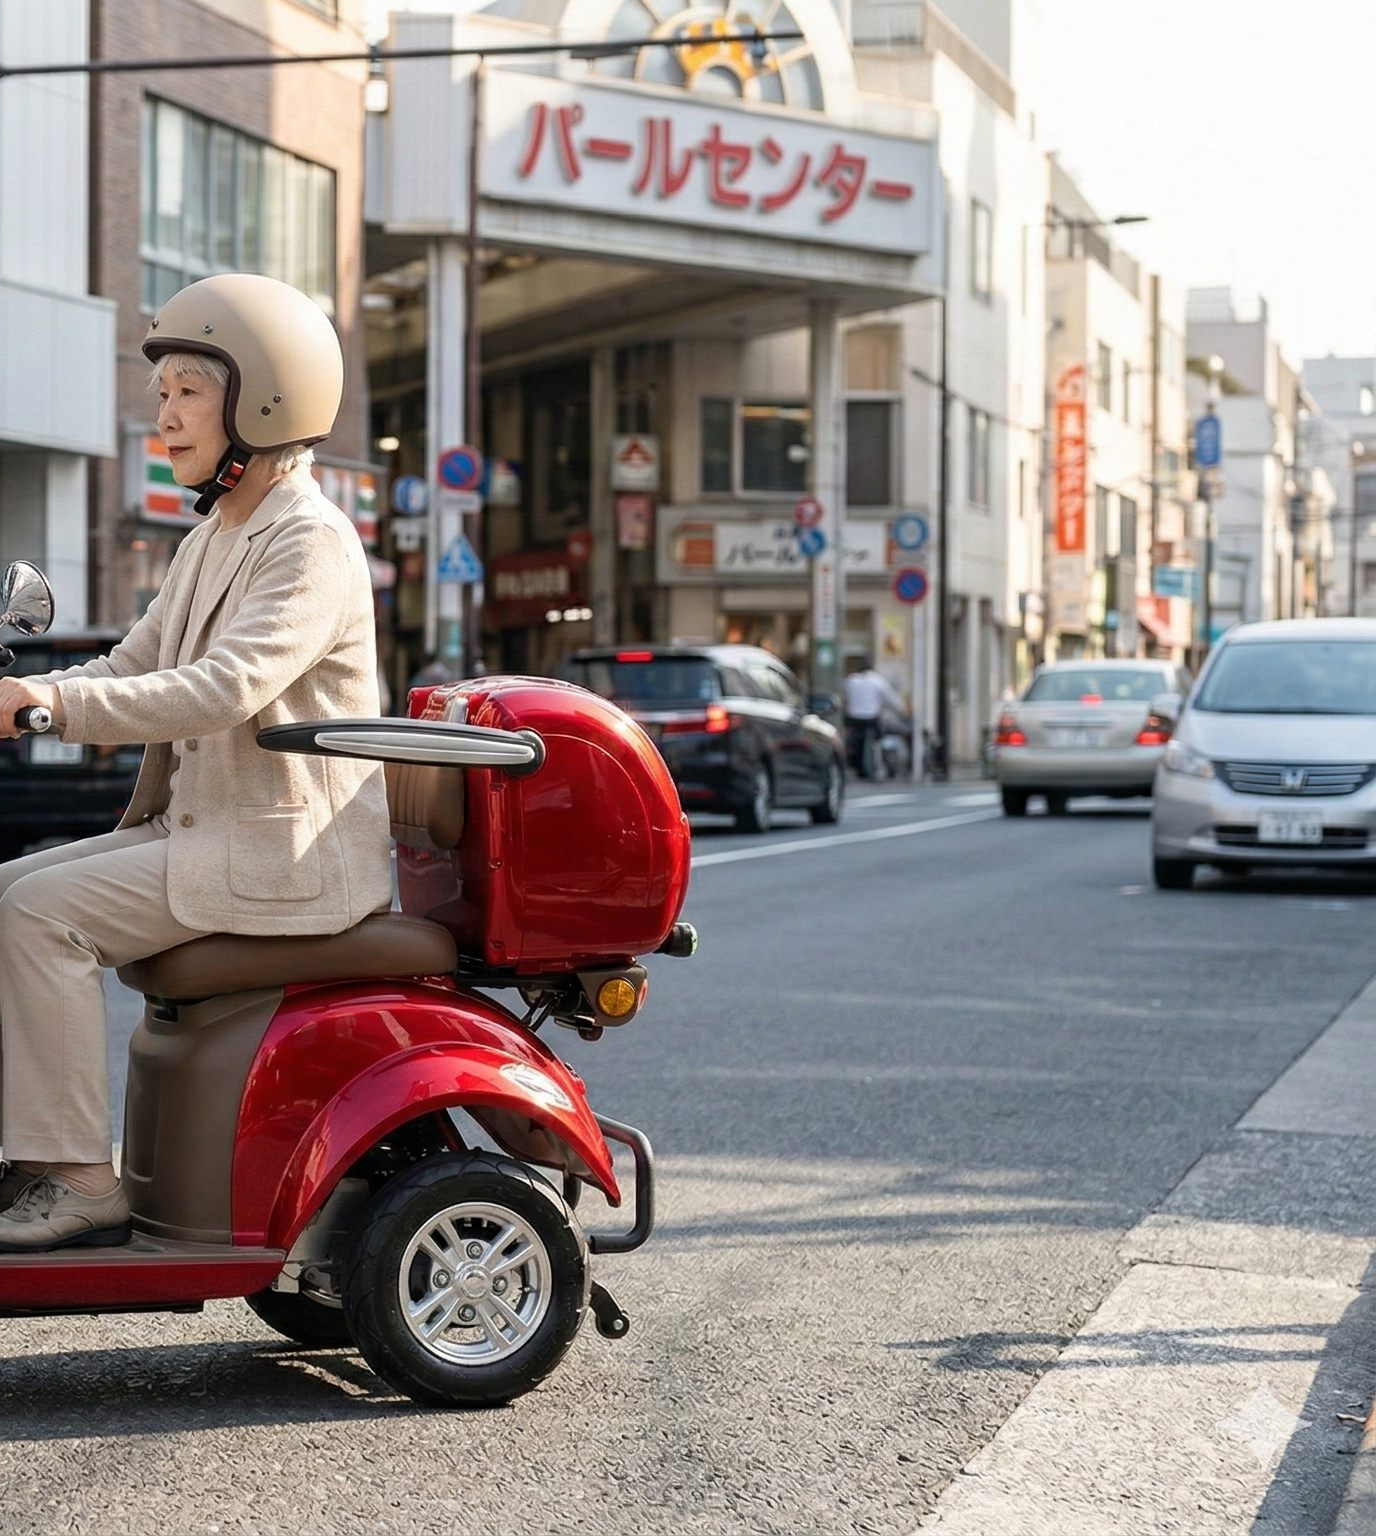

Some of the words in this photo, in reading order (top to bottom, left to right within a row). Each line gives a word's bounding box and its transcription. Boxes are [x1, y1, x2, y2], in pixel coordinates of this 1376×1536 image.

[520, 102, 914, 221] パールセンター
